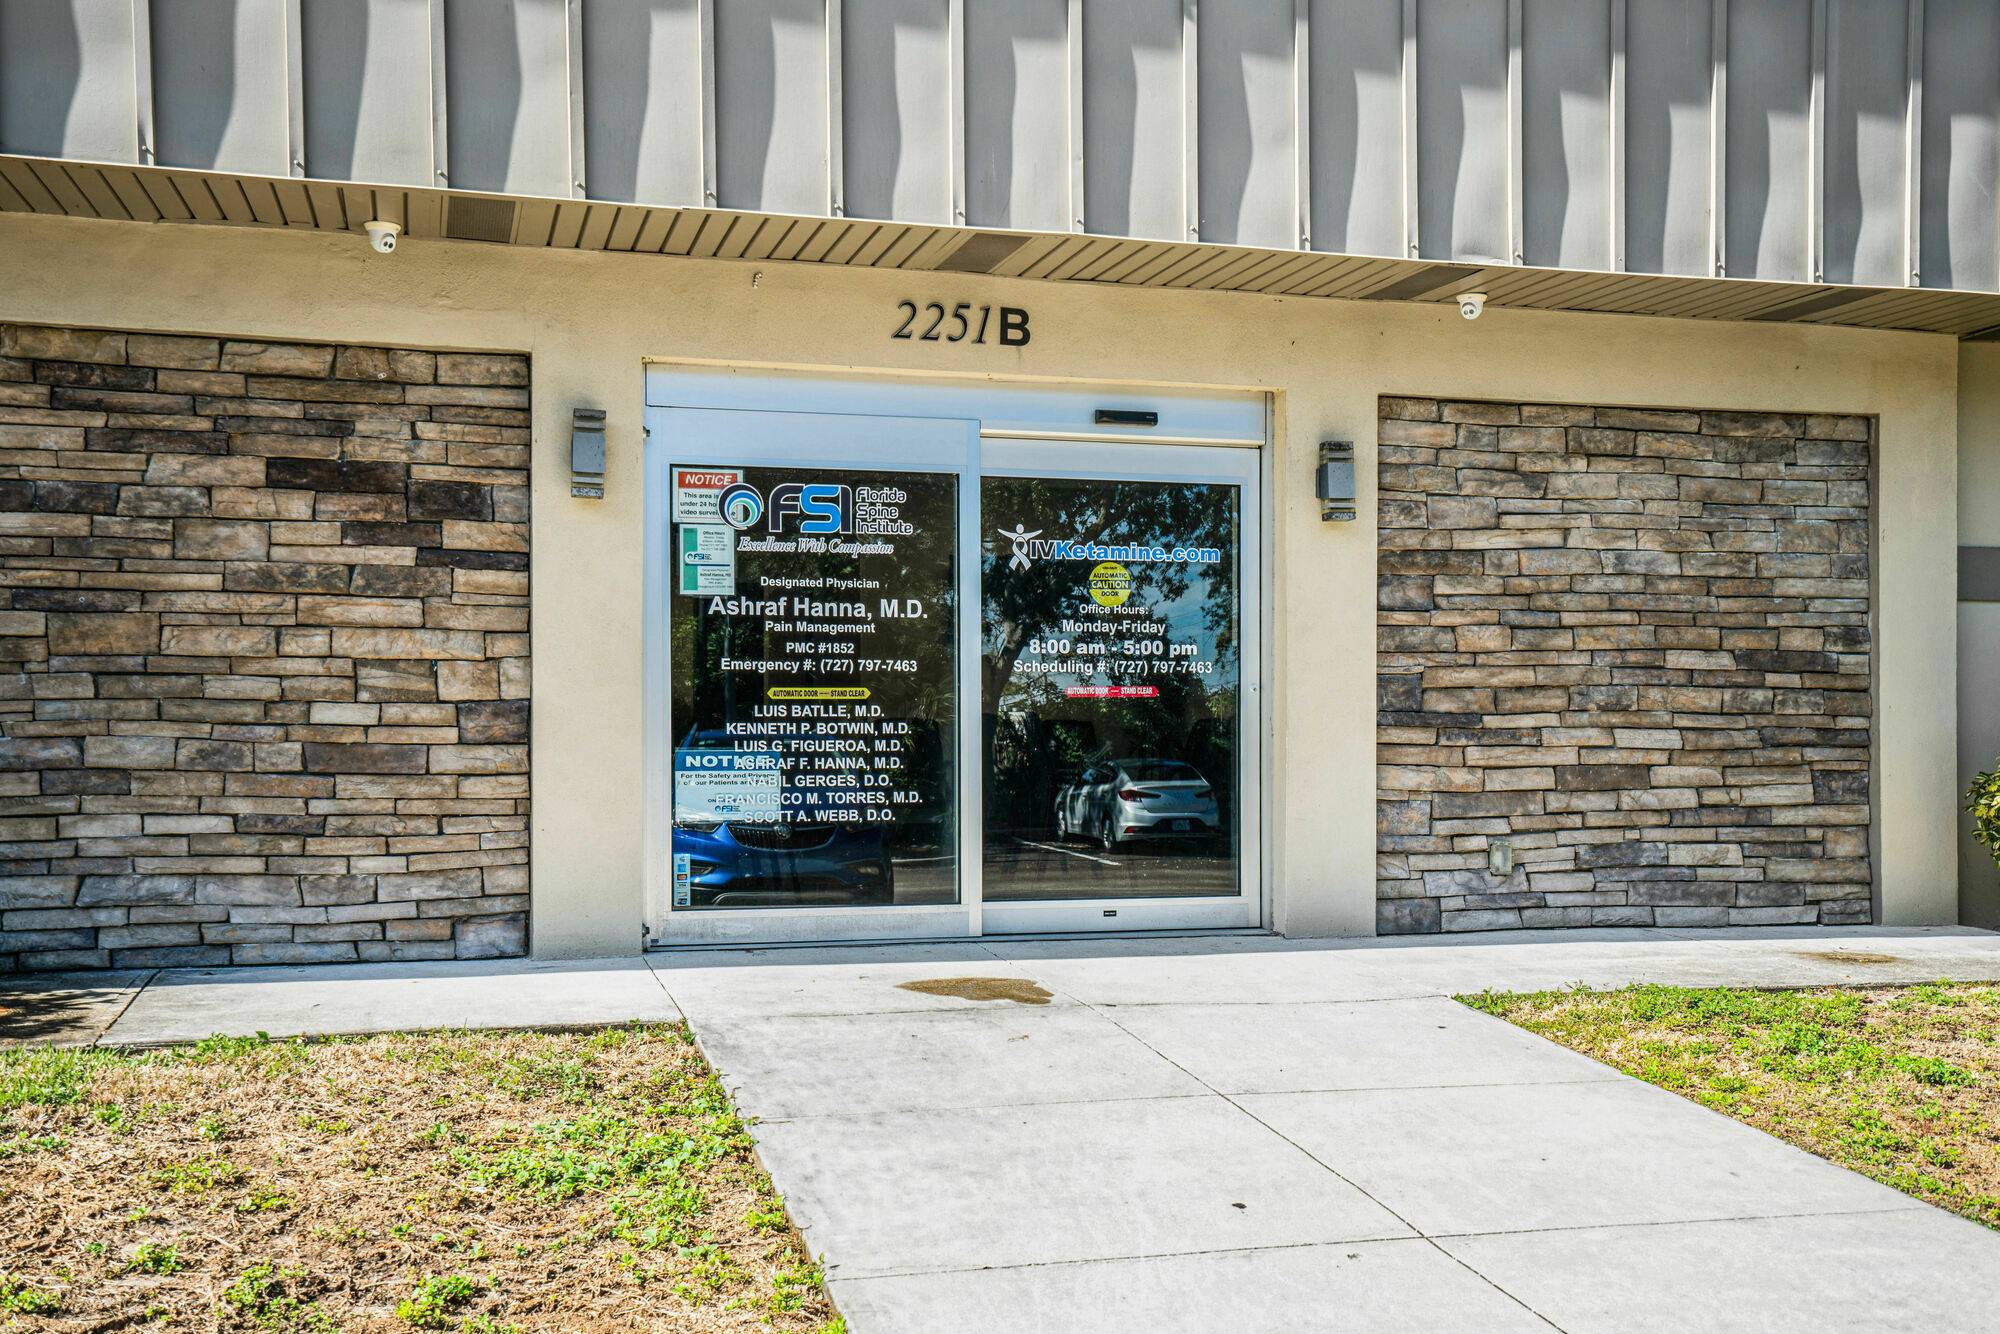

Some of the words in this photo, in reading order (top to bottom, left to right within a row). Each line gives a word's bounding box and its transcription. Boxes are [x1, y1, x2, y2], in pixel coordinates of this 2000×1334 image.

[685, 474, 732, 485] NOTICE
[856, 486, 907, 504] Florida
[769, 483, 852, 534] FSI
[856, 503, 899, 519] Spine
[856, 519, 914, 535] Institute
[737, 536, 797, 553] Excellence
[797, 538, 827, 553] With
[828, 541, 895, 558] Compassion
[1029, 540, 1221, 563] IVKetamine.com
[760, 576, 824, 590] Designated
[826, 578, 880, 590] Physician
[1091, 581, 1129, 589] CAUTION
[708, 595, 787, 616] Ashraf
[794, 597, 872, 620] Hanna,
[880, 599, 928, 619] M.D.
[1079, 604, 1112, 615] Office
[1114, 604, 1149, 615] Hours:
[764, 621, 794, 632] Pain
[796, 621, 876, 636] Management
[1062, 620, 1166, 636] Monday-Friday
[786, 642, 815, 653] PMC
[818, 643, 855, 654] #1852
[1029, 640, 1070, 654] 8:00
[1076, 643, 1105, 655] am
[1123, 640, 1165, 655] 5:00
[1169, 643, 1198, 658] pm
[721, 658, 800, 674] Emergency
[803, 660, 816, 671] #:
[820, 659, 854, 674] (727)
[858, 660, 918, 672] 797-7463
[1013, 660, 1093, 676] Scheduling
[1096, 661, 1109, 673] #:
[1114, 660, 1148, 676] (727)
[1152, 661, 1213, 674] 797-7463
[754, 705, 787, 717] LUIS
[791, 705, 851, 720] BATLLE,
[855, 705, 884, 717] M.D.
[726, 722, 796, 735] KENNETH
[801, 722, 813, 734] P.
[816, 722, 878, 737] BOTWIN,
[882, 722, 912, 734] M.D.
[734, 740, 768, 752] LUIS
[772, 740, 787, 752] G.
[791, 740, 870, 753] FIGUEROA,
[874, 739, 904, 752] M.D.
[734, 757, 795, 770] ASHRAF
[799, 757, 811, 769] F.
[815, 757, 871, 771] HANNA,
[874, 756, 904, 769] M.D.
[747, 775, 791, 787] NABIL
[794, 775, 860, 788] GERGES,
[864, 774, 893, 786] D.O.
[716, 792, 802, 805] FRANCISCO
[806, 792, 822, 804] M.
[826, 792, 889, 806] TORRES,
[893, 791, 923, 804] M.D.
[743, 810, 793, 823] SCOTT
[797, 810, 812, 822] A.
[815, 810, 862, 824] WEBB,
[867, 809, 896, 822] D.O.
